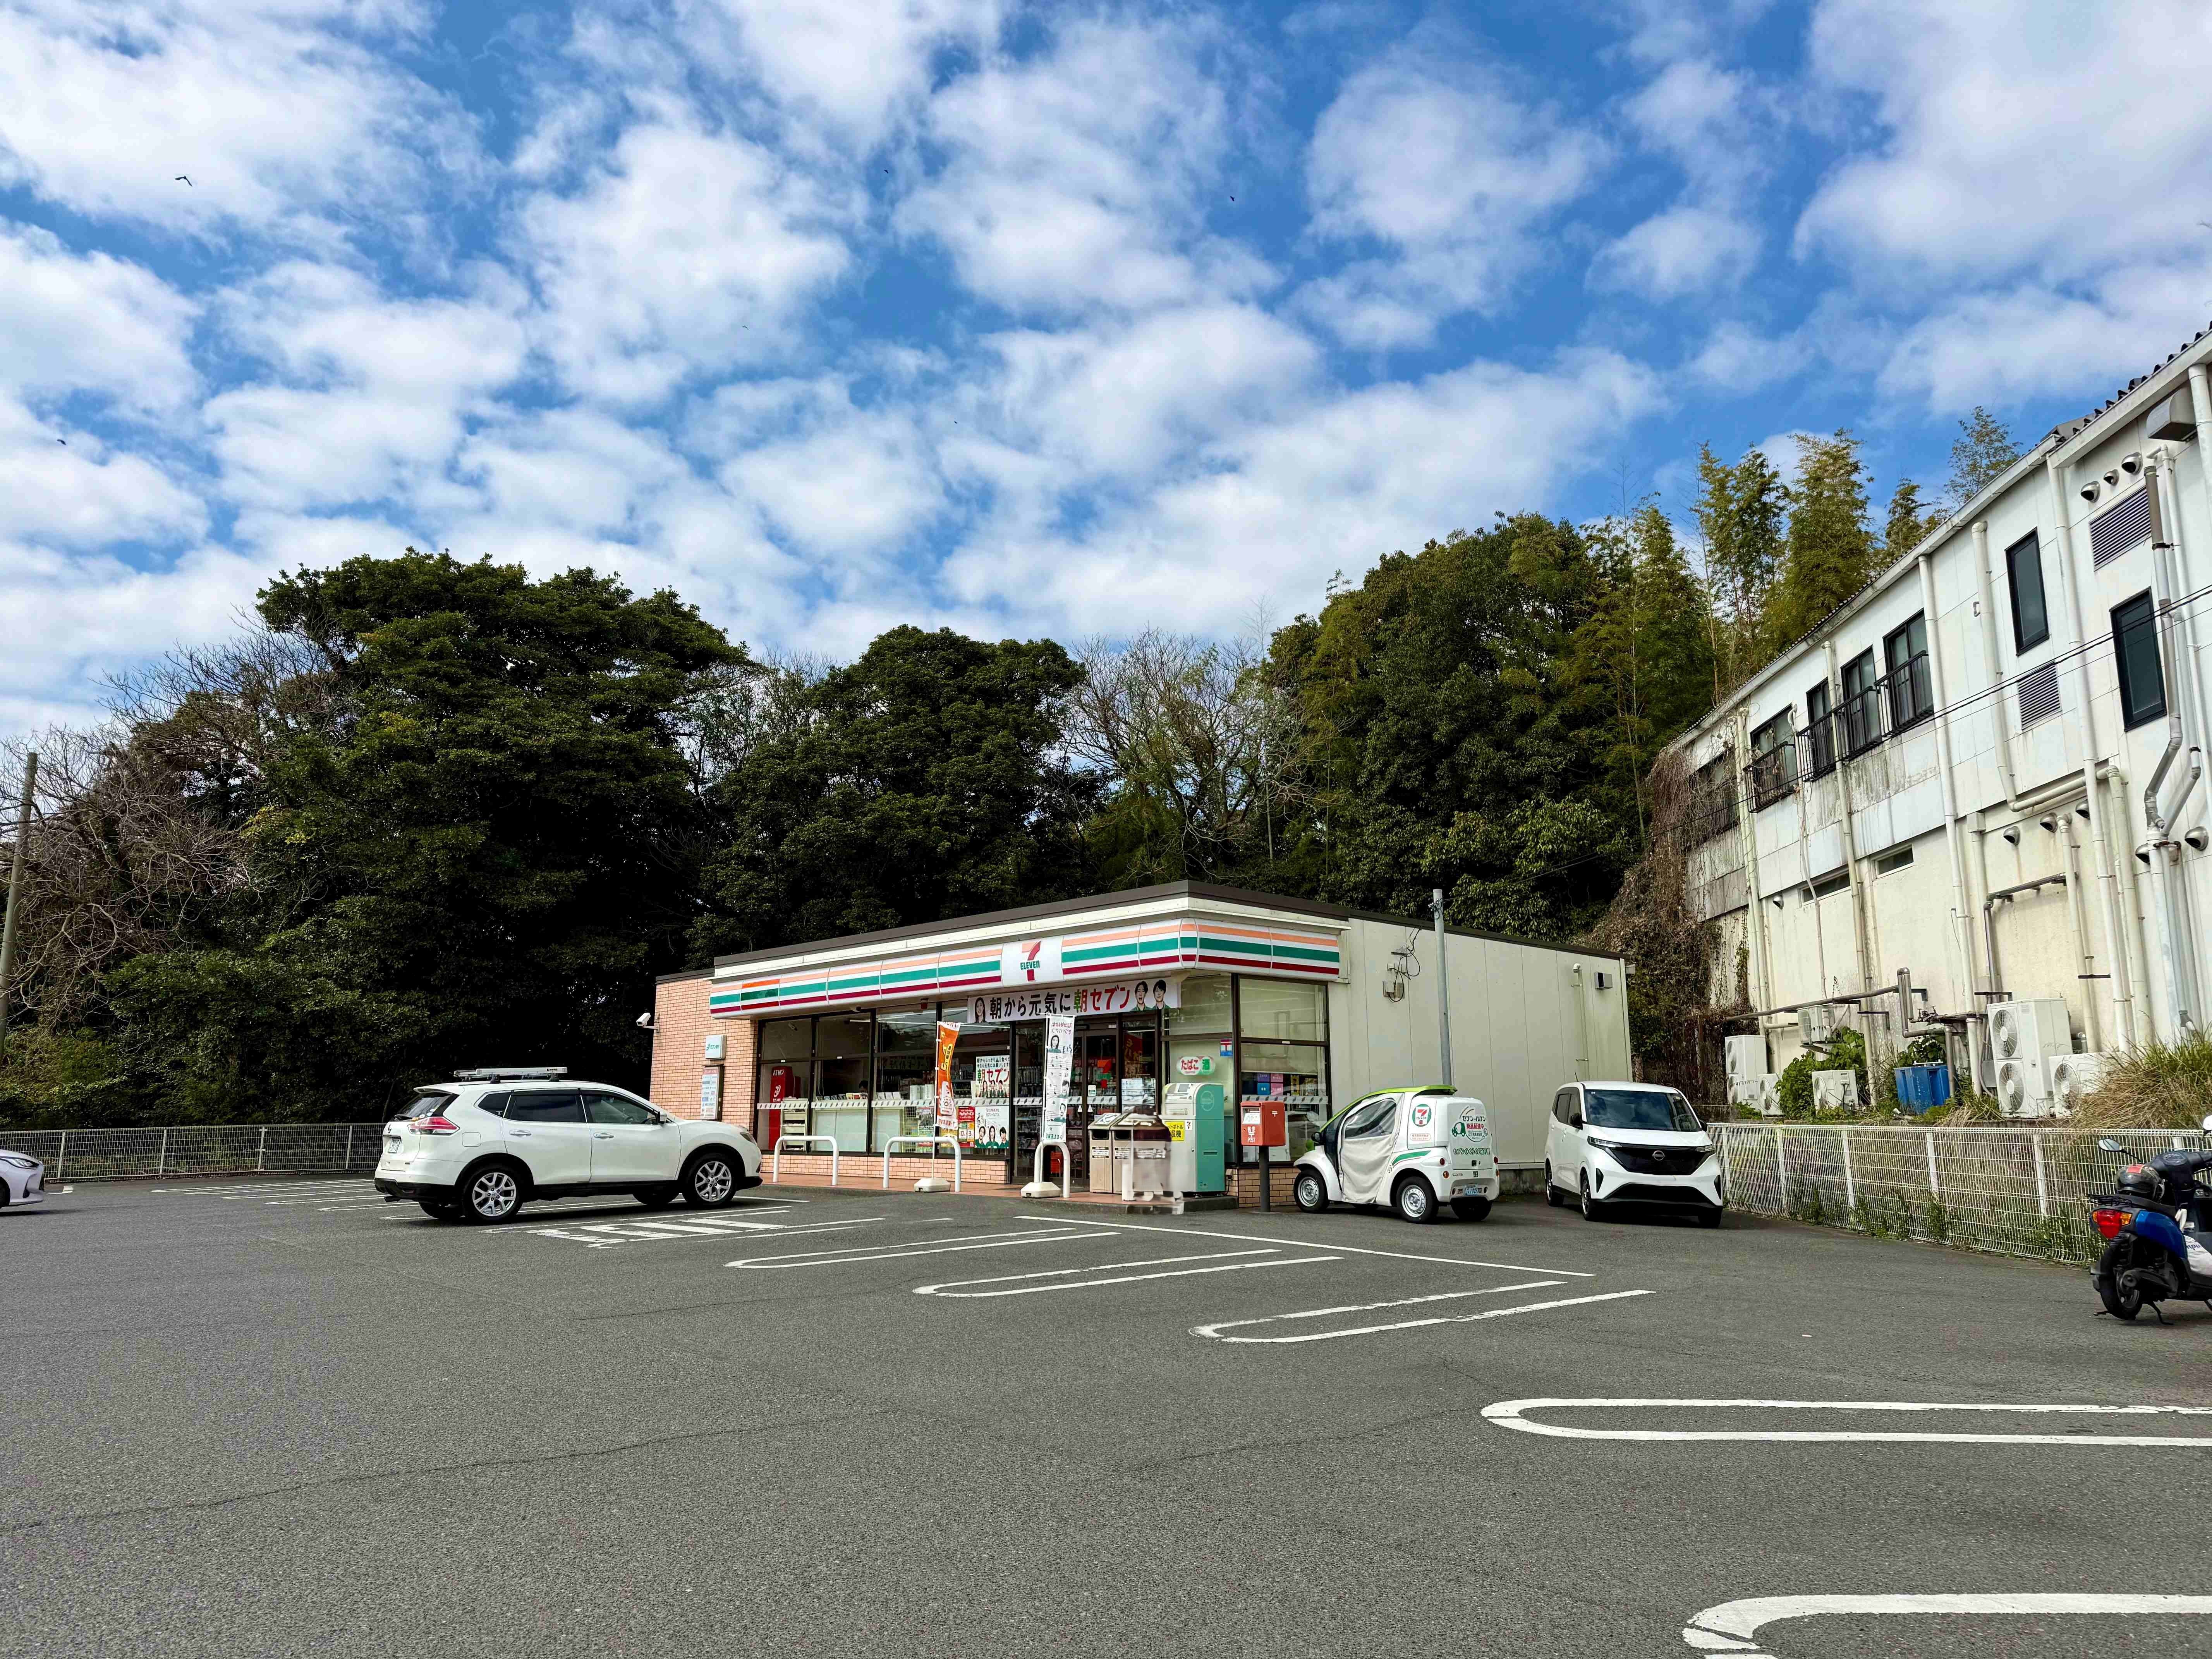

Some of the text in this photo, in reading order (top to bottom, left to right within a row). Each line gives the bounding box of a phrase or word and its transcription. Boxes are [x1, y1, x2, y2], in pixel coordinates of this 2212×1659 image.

[989, 984, 1130, 1020] 朝から元気に朝セブン
[1182, 1059, 1210, 1070] たばこ 酒
